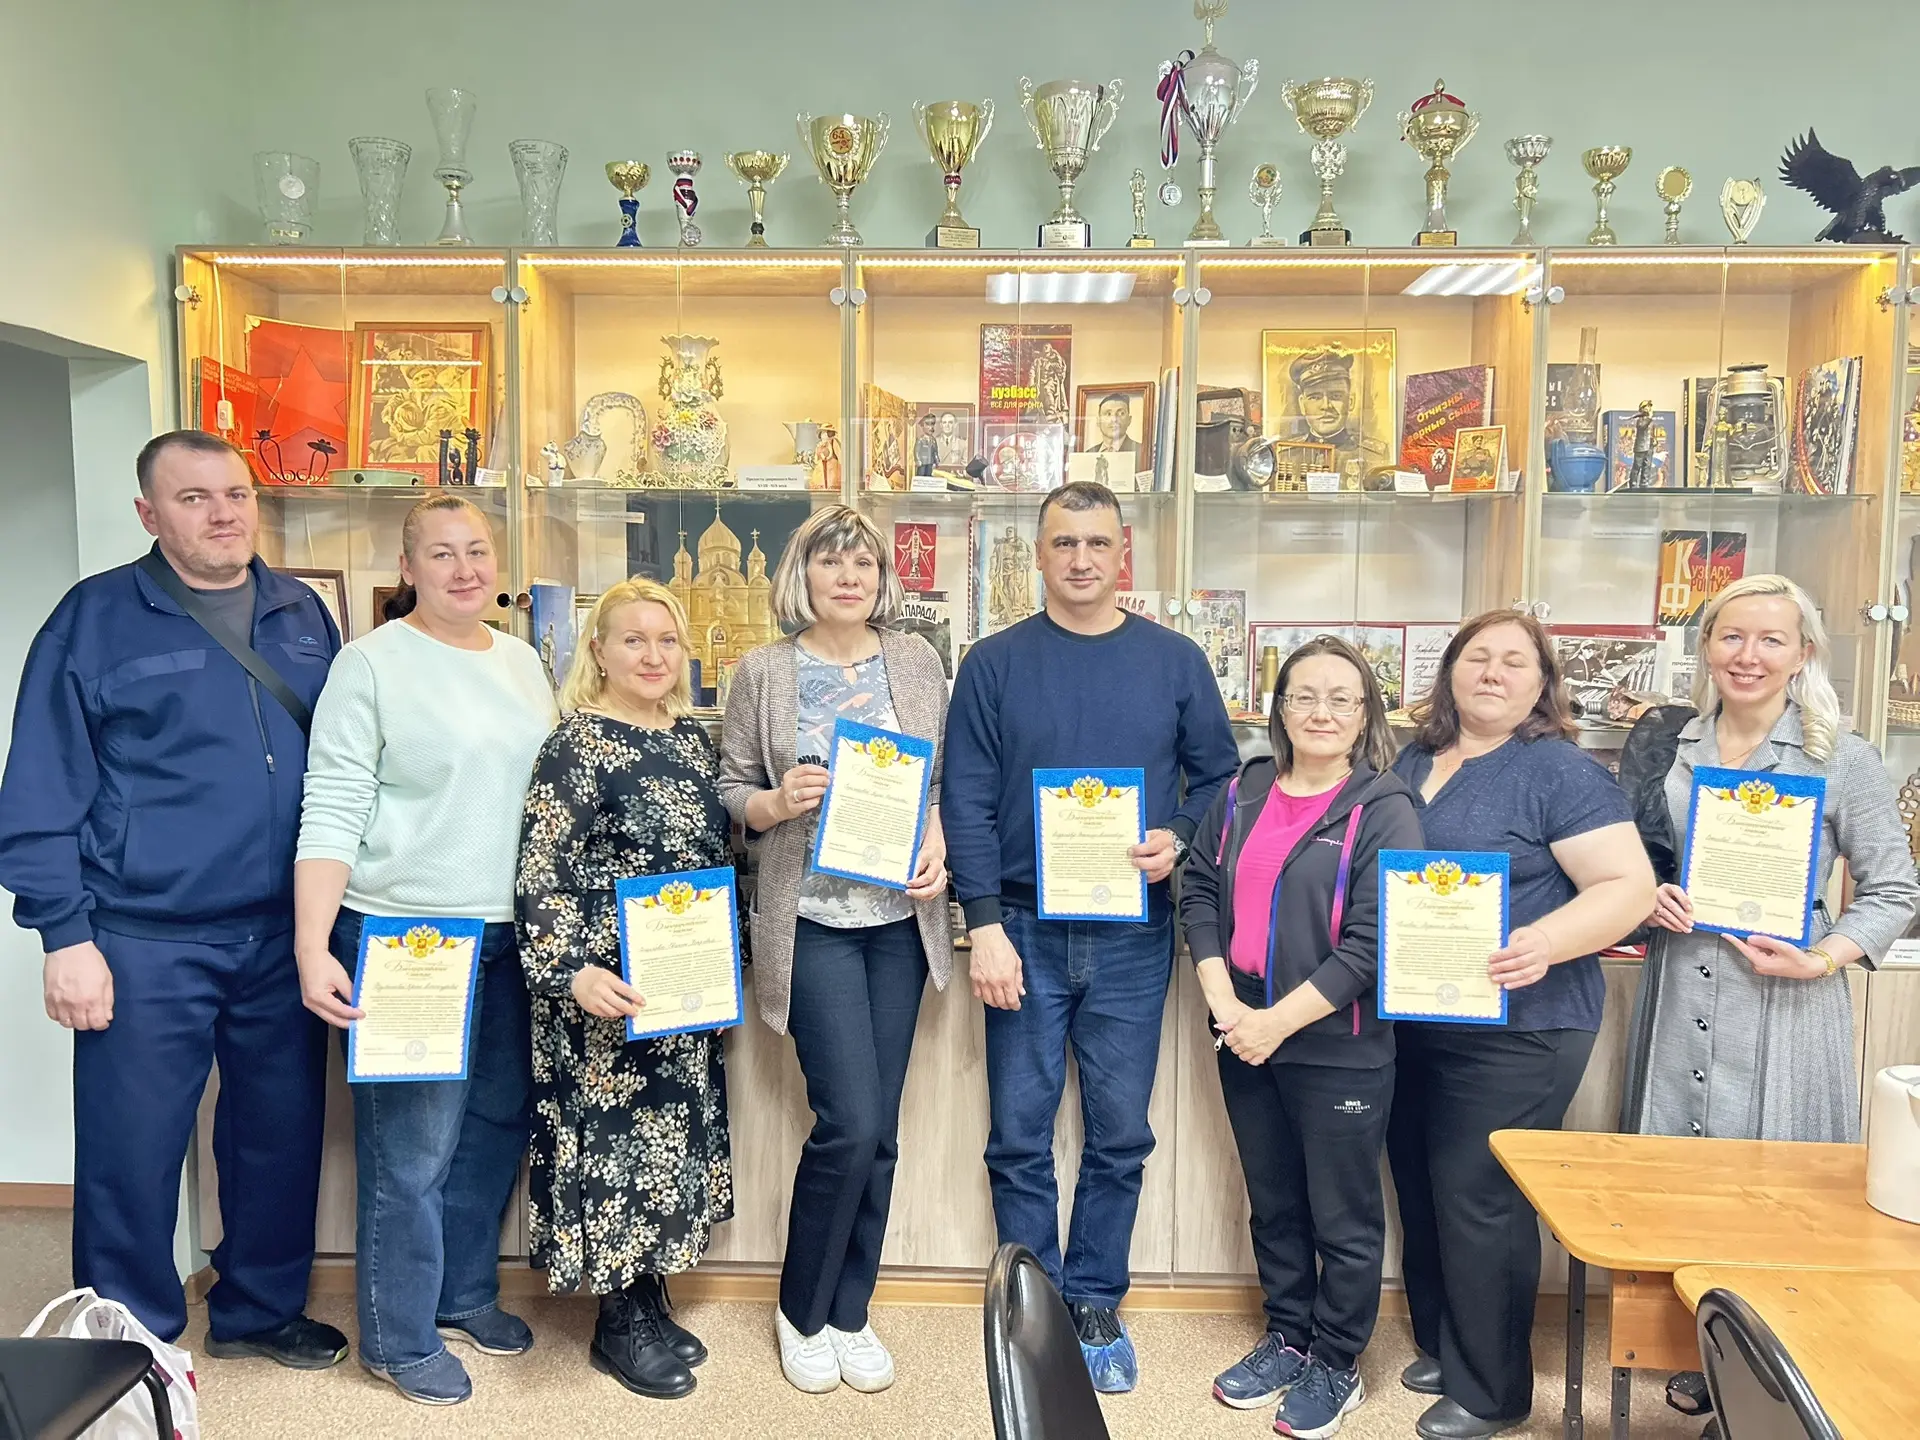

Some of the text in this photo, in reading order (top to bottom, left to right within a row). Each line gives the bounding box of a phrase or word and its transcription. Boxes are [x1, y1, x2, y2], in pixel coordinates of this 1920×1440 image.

[832, 130, 845, 140] 65
[991, 385, 1037, 399] кузбасс
[1003, 400, 1017, 409] ДЛЯ
[1017, 400, 1044, 410] ФРОНТА
[1416, 392, 1465, 423] Отчизны
[1407, 398, 1481, 446] верные сыны
[904, 603, 937, 622] ПАРАДА
